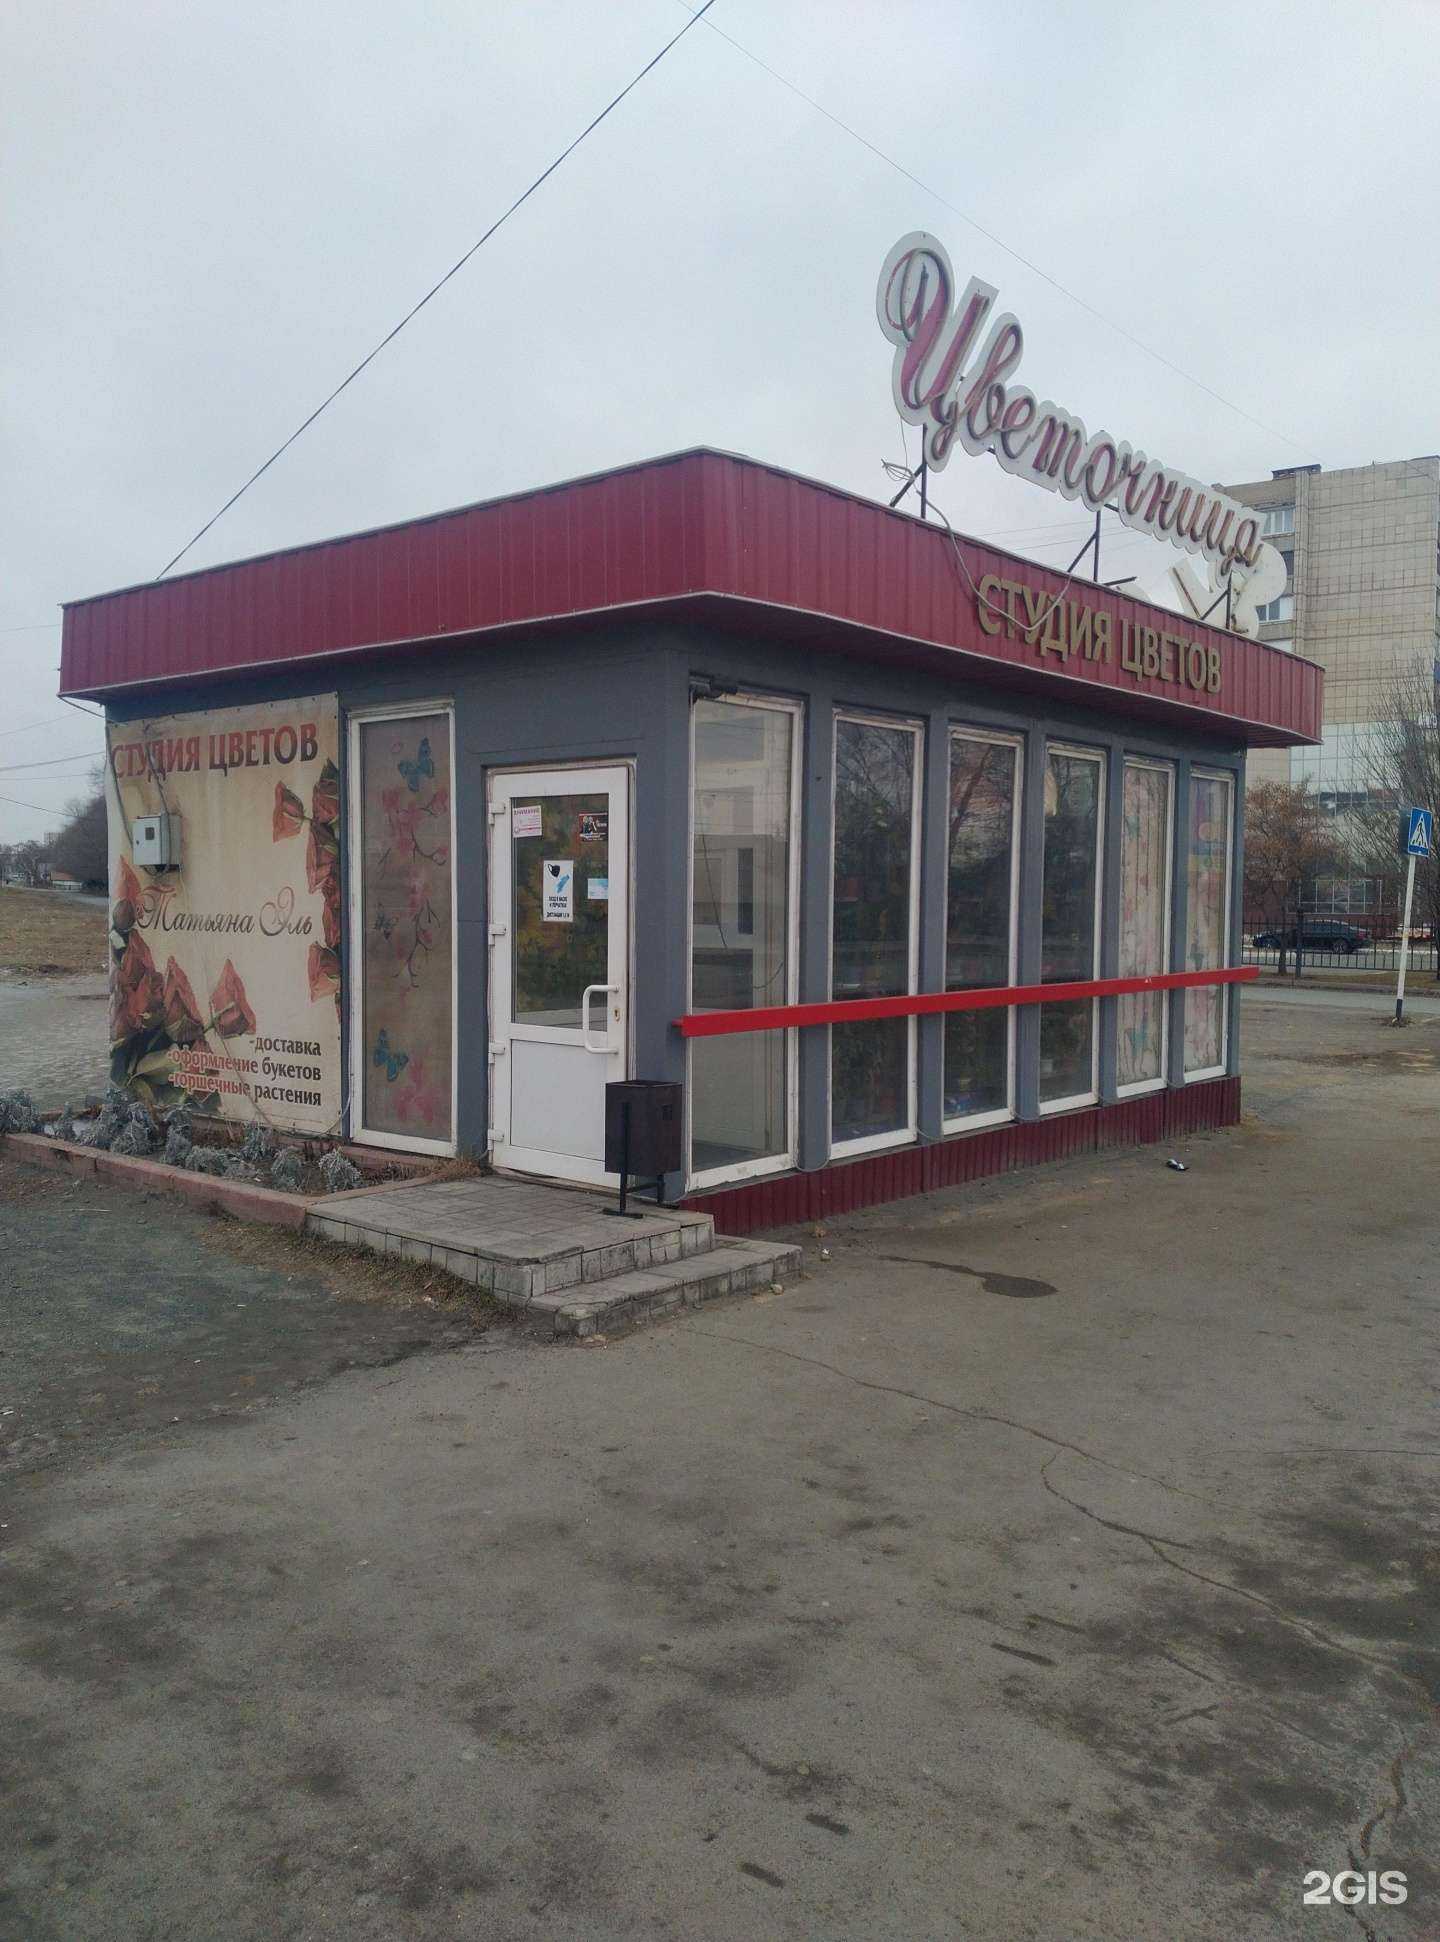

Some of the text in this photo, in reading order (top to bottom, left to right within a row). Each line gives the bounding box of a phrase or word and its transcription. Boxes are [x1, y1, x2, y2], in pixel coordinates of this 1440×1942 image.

[884, 246, 1265, 578] Цветочница
[977, 574, 1222, 694] СТУДИЯ ЦВЕТОВ
[111, 722, 319, 782] СТУДИЯ ЦВЕТОВ
[136, 884, 254, 934] Татьяна
[168, 1050, 321, 1080] -оформление букетов
[249, 1037, 321, 1056] -доставка
[169, 1072, 322, 1106] -горшечные растения
